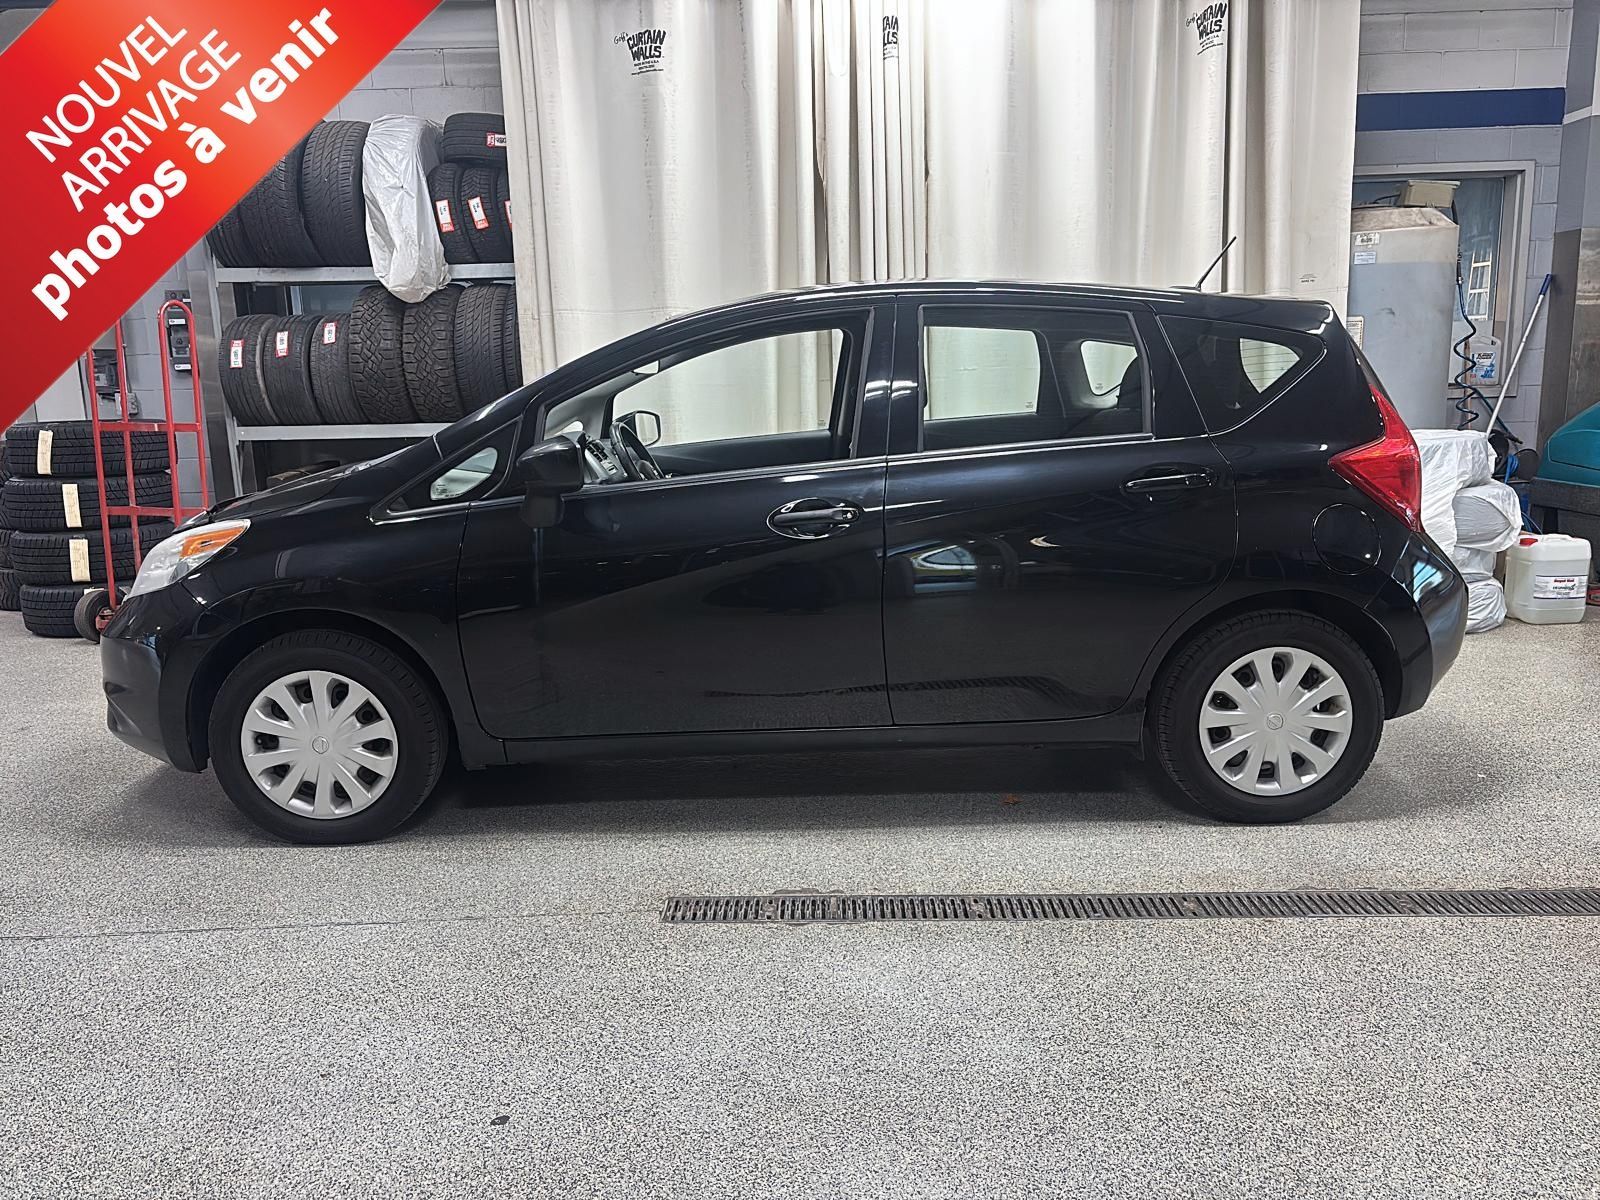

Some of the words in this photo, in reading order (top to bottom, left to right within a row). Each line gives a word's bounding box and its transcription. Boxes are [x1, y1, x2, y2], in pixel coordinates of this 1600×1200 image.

[1196, 3, 1228, 29] CURTAIN
[626, 29, 667, 50] CURTAIN
[1198, 19, 1223, 41] WALLS
[630, 45, 662, 61] WALLS
